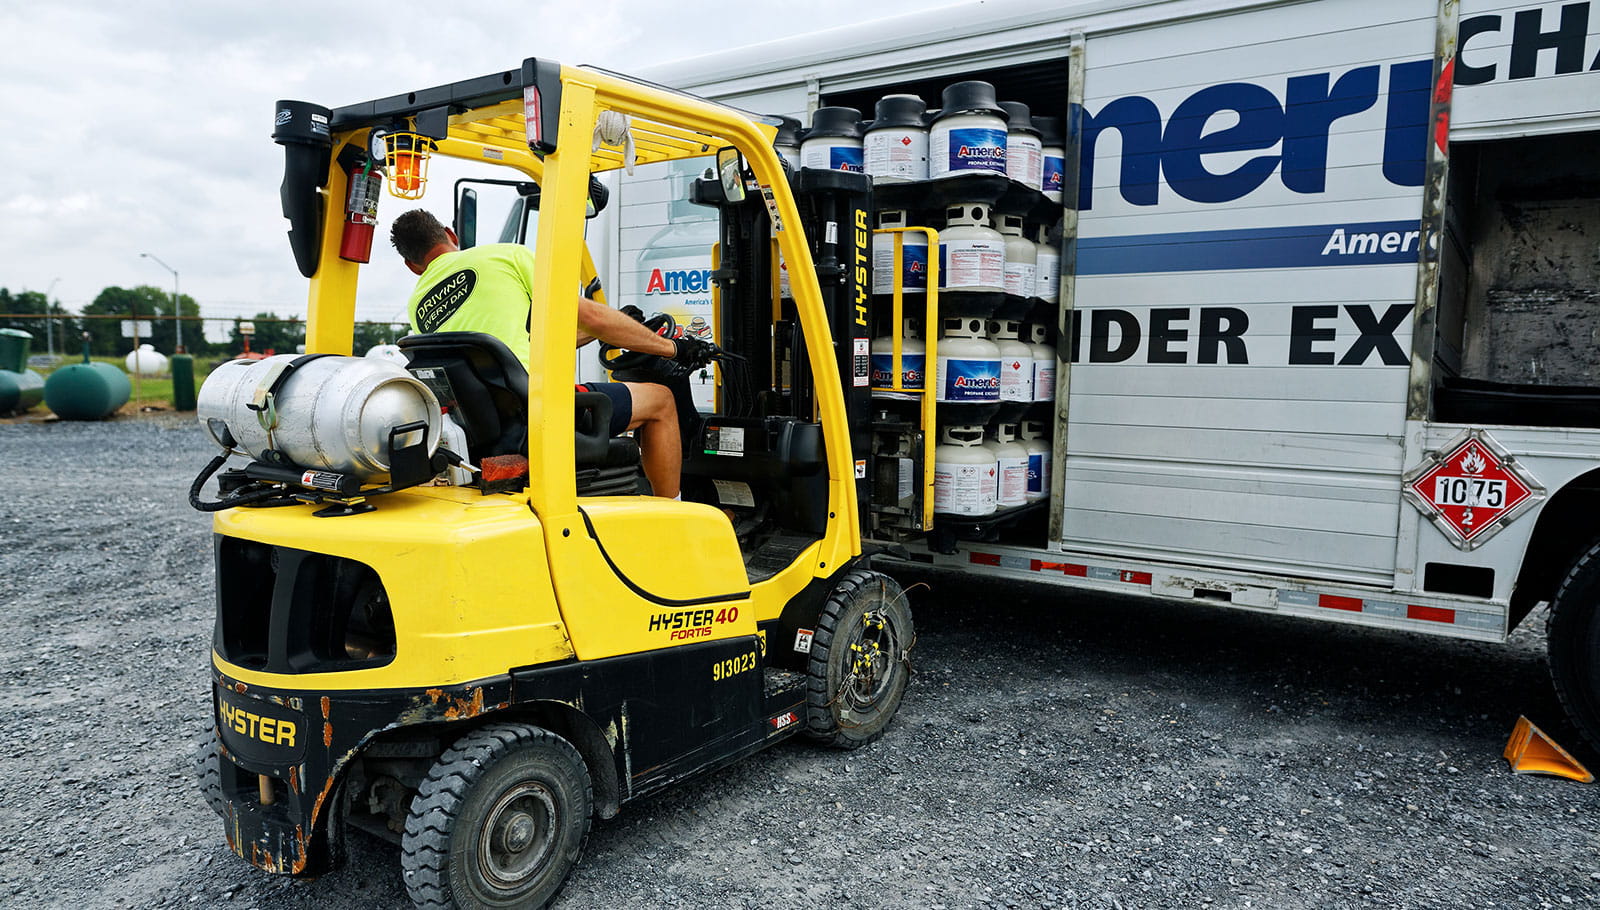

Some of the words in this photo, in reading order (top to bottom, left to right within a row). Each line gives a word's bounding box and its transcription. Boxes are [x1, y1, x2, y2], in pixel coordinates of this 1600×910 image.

[1453, 1, 1600, 86] CH
[855, 209, 867, 326] HYSTER
[418, 272, 466, 320] DRIVING
[424, 300, 449, 330] EVERY
[450, 284, 468, 304] DAY
[1288, 303, 1416, 366] EX
[1440, 478, 1503, 507] 1075
[1461, 511, 1474, 525] 2
[648, 609, 714, 631] HYSTER
[715, 607, 739, 625] 40
[670, 626, 712, 641] FORTIS
[713, 651, 756, 681] 913023
[219, 695, 297, 748] HYSTER
[776, 712, 792, 729] HSS
